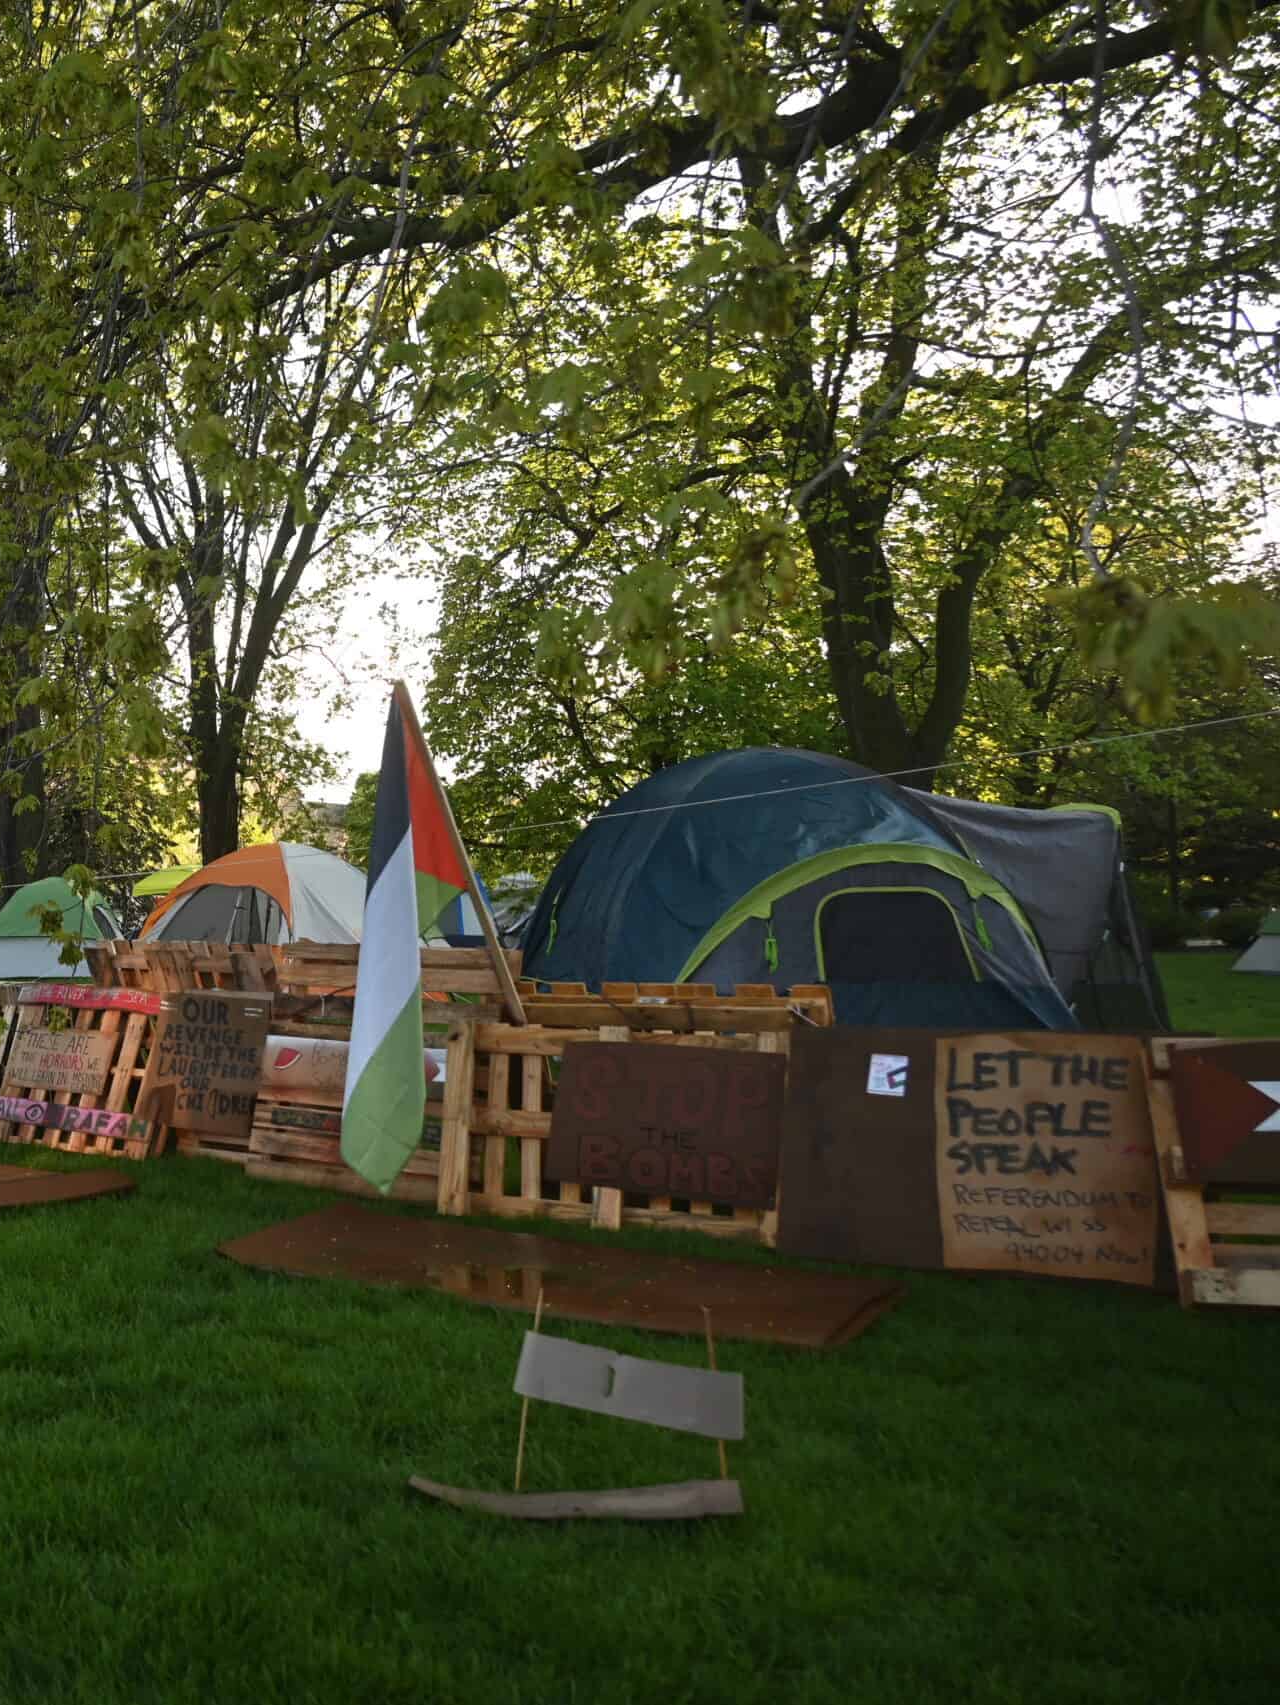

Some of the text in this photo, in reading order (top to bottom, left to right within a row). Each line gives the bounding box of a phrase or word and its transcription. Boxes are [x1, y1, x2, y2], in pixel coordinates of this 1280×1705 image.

[183, 997, 229, 1025] OUR
[27, 1032, 96, 1055] THESE ARE
[165, 1024, 243, 1044] REVENGE
[160, 1042, 201, 1057] WILL
[226, 1046, 257, 1062] THE
[158, 1057, 238, 1079] LAUGHTER
[947, 1047, 1130, 1092] LET THE
[575, 1056, 768, 1124] STOP
[946, 1096, 1112, 1137] PEOPLE
[640, 1127, 697, 1150] THE
[579, 1136, 767, 1197] BOMBS
[946, 1140, 1078, 1176] SPEAK
